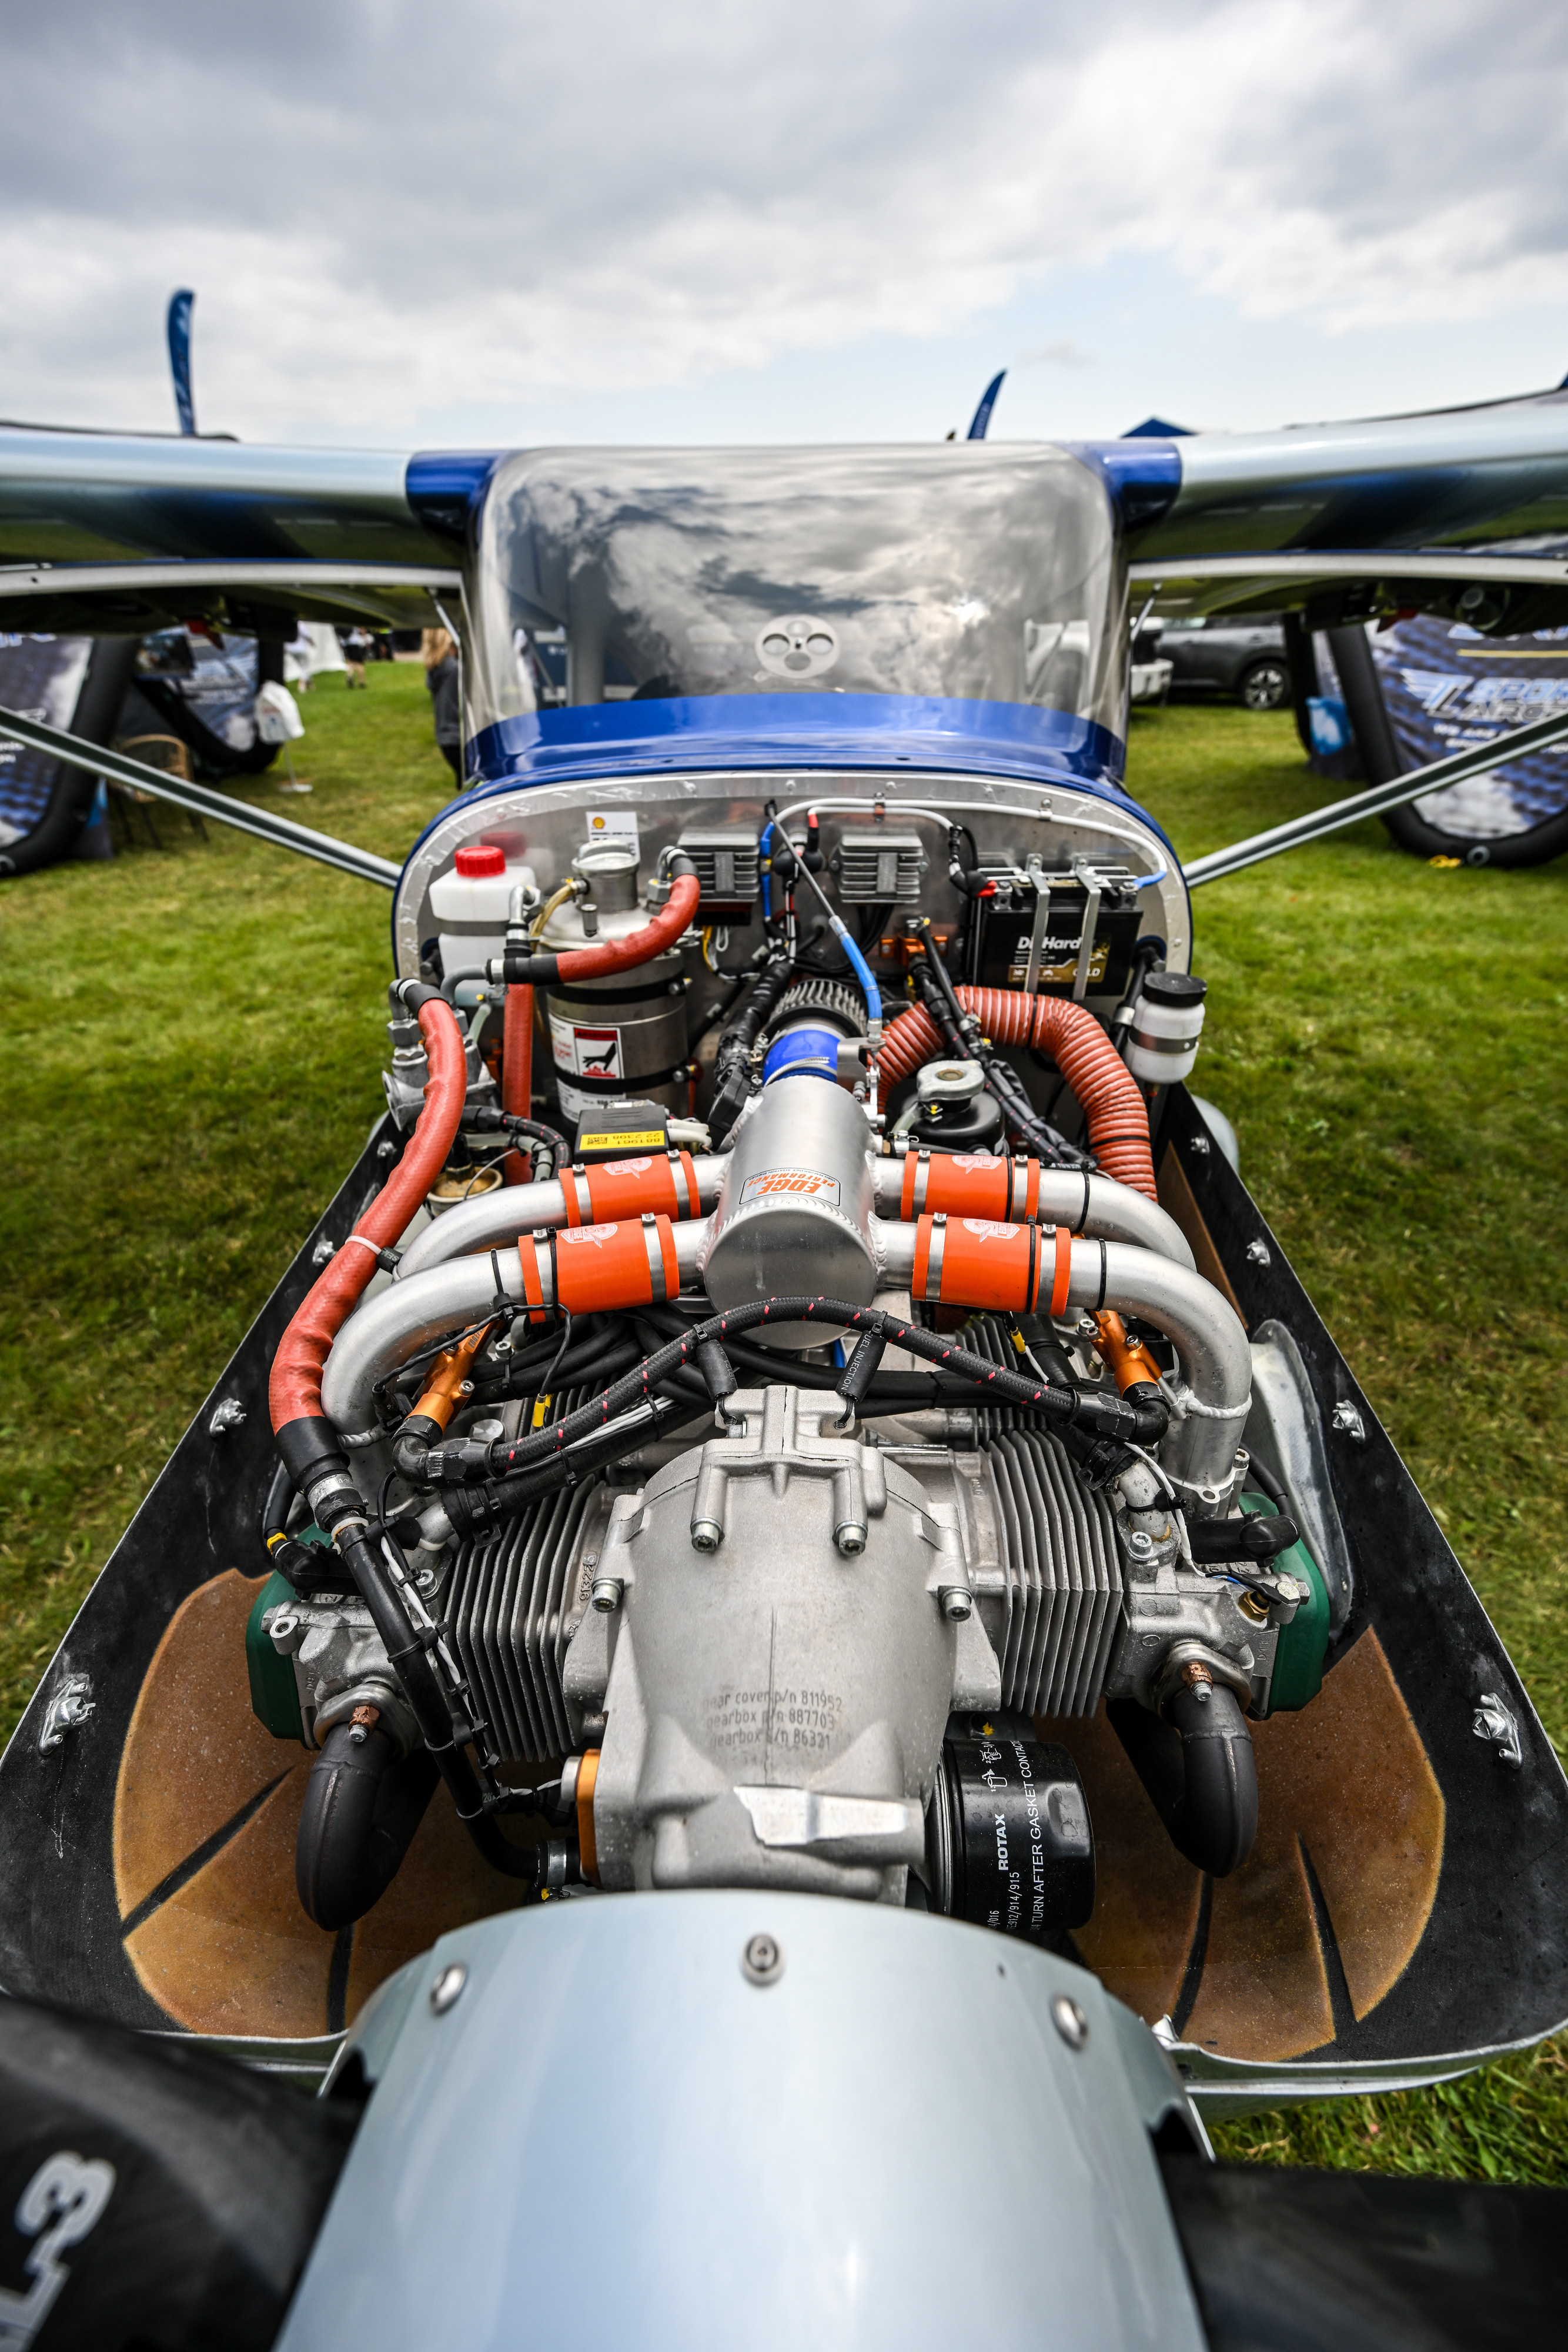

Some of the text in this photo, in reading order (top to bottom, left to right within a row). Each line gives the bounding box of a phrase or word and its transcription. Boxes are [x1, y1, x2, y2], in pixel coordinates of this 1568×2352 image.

[1017, 936, 1083, 950] DiHard
[747, 1172, 835, 1188] PERFORMANCE
[757, 1178, 822, 1195] EDGE
[841, 1332, 873, 1391] UEL INJECTION
[735, 1691, 770, 1705] cover
[801, 1690, 842, 1712] 811952
[707, 1710, 757, 1729] gearbox
[789, 1709, 834, 1730] 887703
[710, 1728, 761, 1750] gearbox
[1024, 1781, 1041, 1839] GASKET
[995, 1813, 1009, 1870] ROTAX
[1032, 1844, 1044, 1893] AFTER
[1032, 1896, 1044, 1923] TURN
